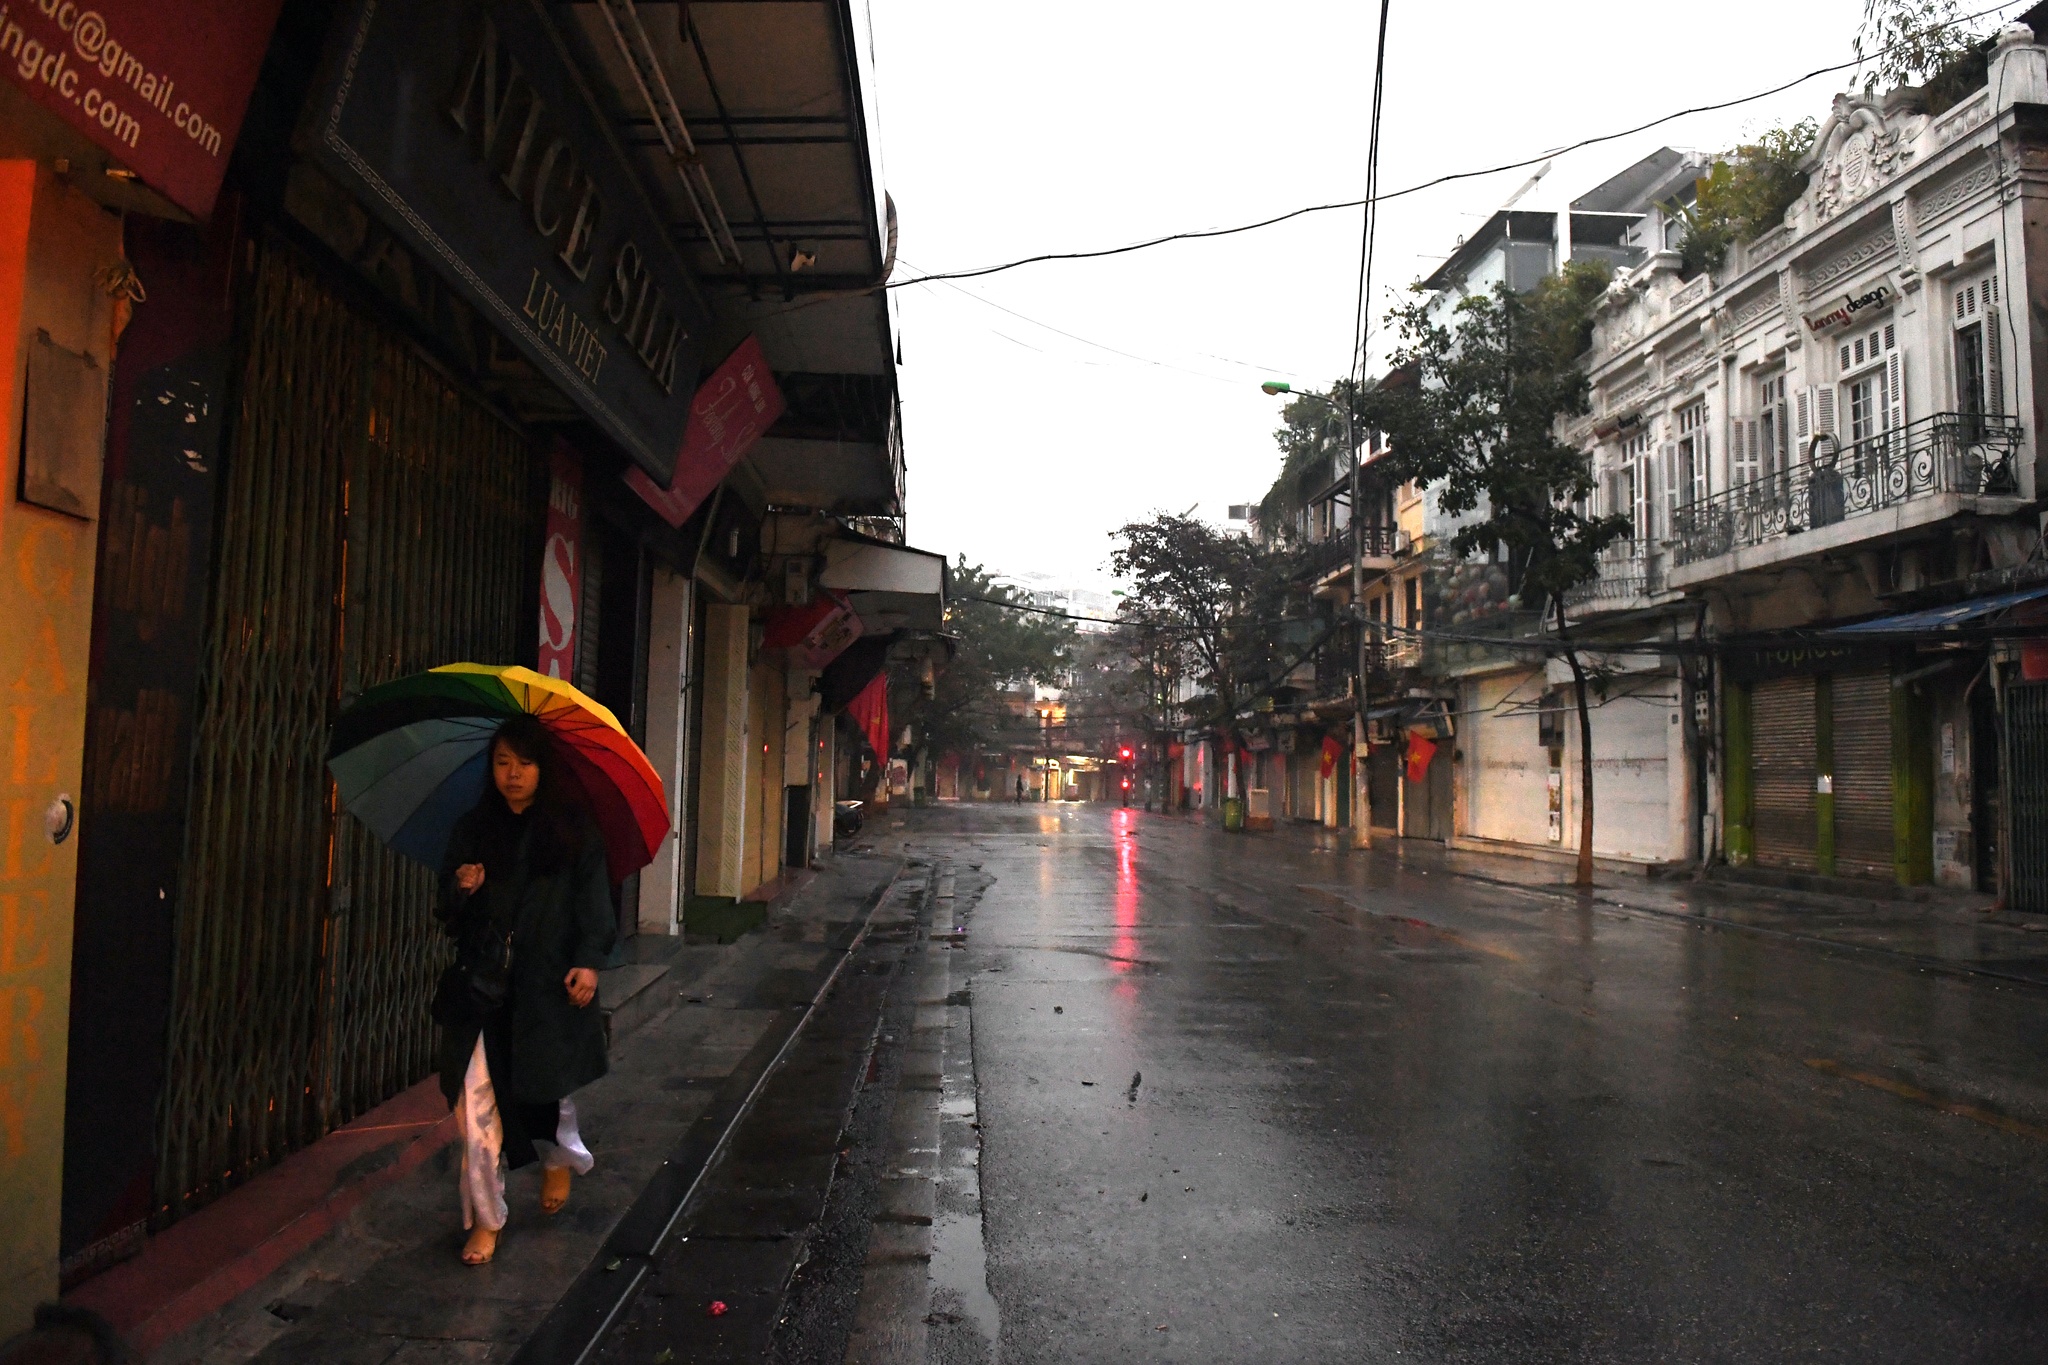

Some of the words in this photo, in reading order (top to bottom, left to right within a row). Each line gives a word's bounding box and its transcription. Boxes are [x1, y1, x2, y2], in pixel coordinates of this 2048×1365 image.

[450, 8, 597, 284] NICE
[601, 241, 690, 396] SILK
[0, 521, 75, 1157] GALLERY
